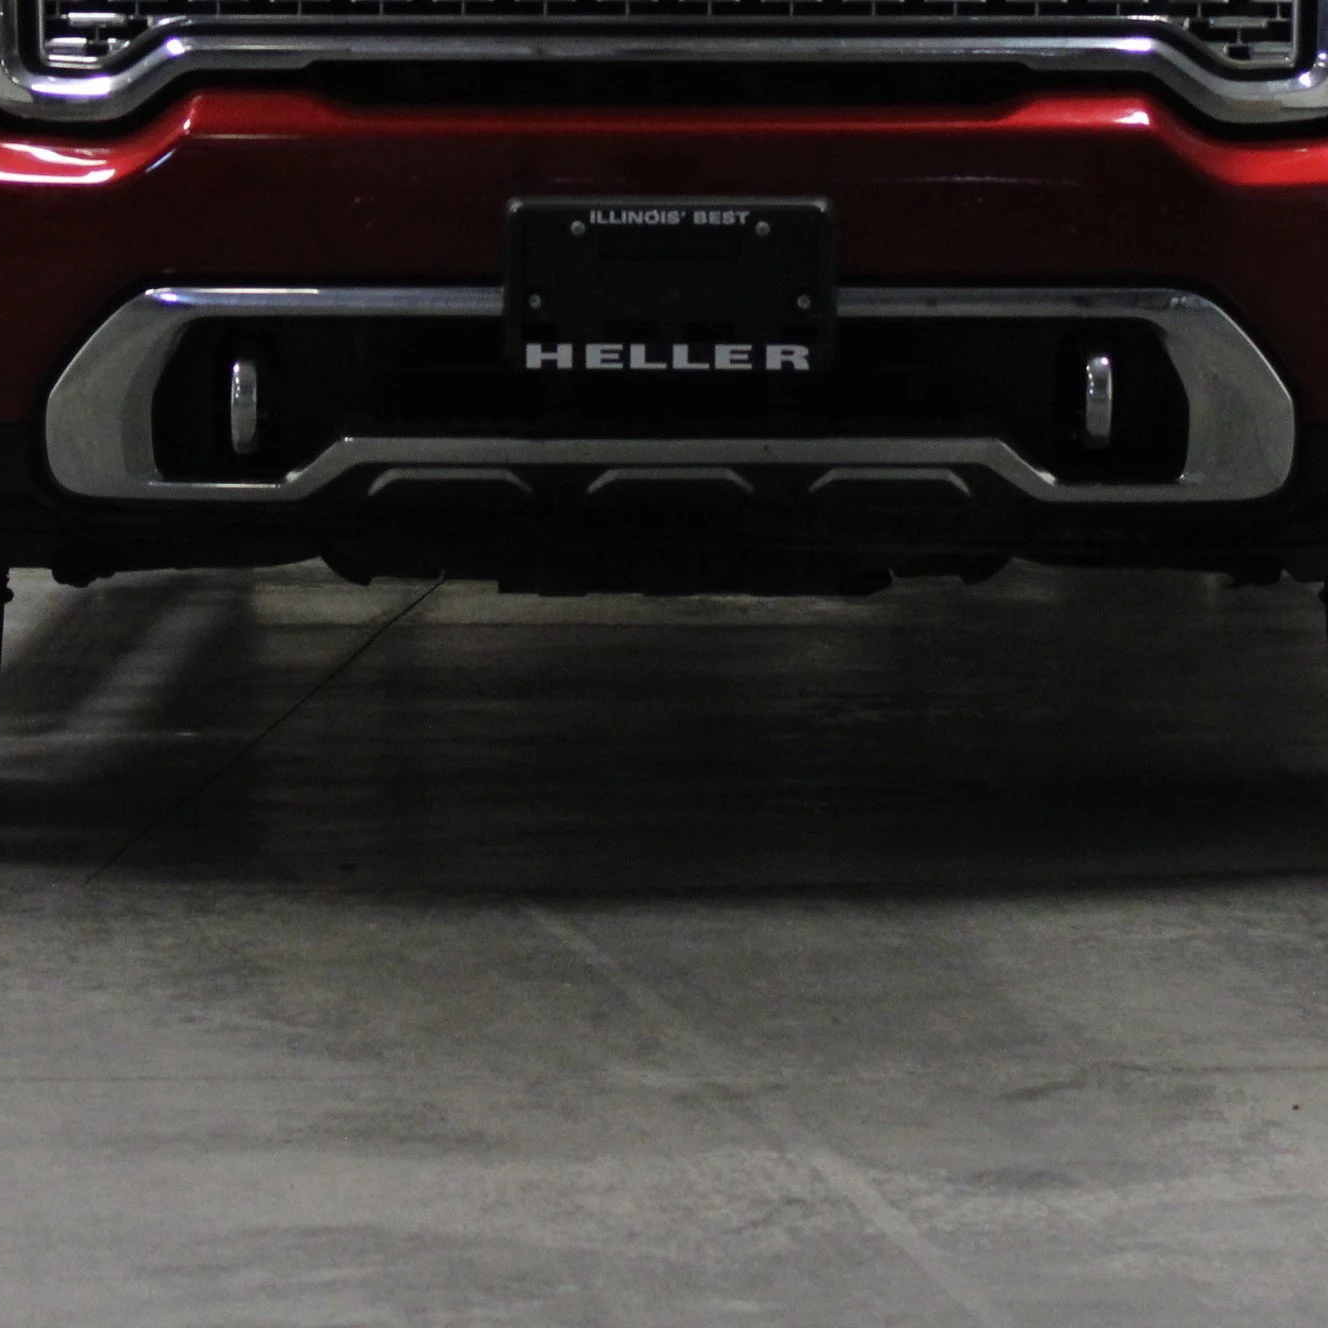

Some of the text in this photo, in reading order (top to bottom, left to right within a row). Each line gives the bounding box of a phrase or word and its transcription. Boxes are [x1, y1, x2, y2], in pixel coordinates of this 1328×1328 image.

[590, 209, 750, 225] ILLINOIS' BEST
[526, 343, 810, 370] HELLER
